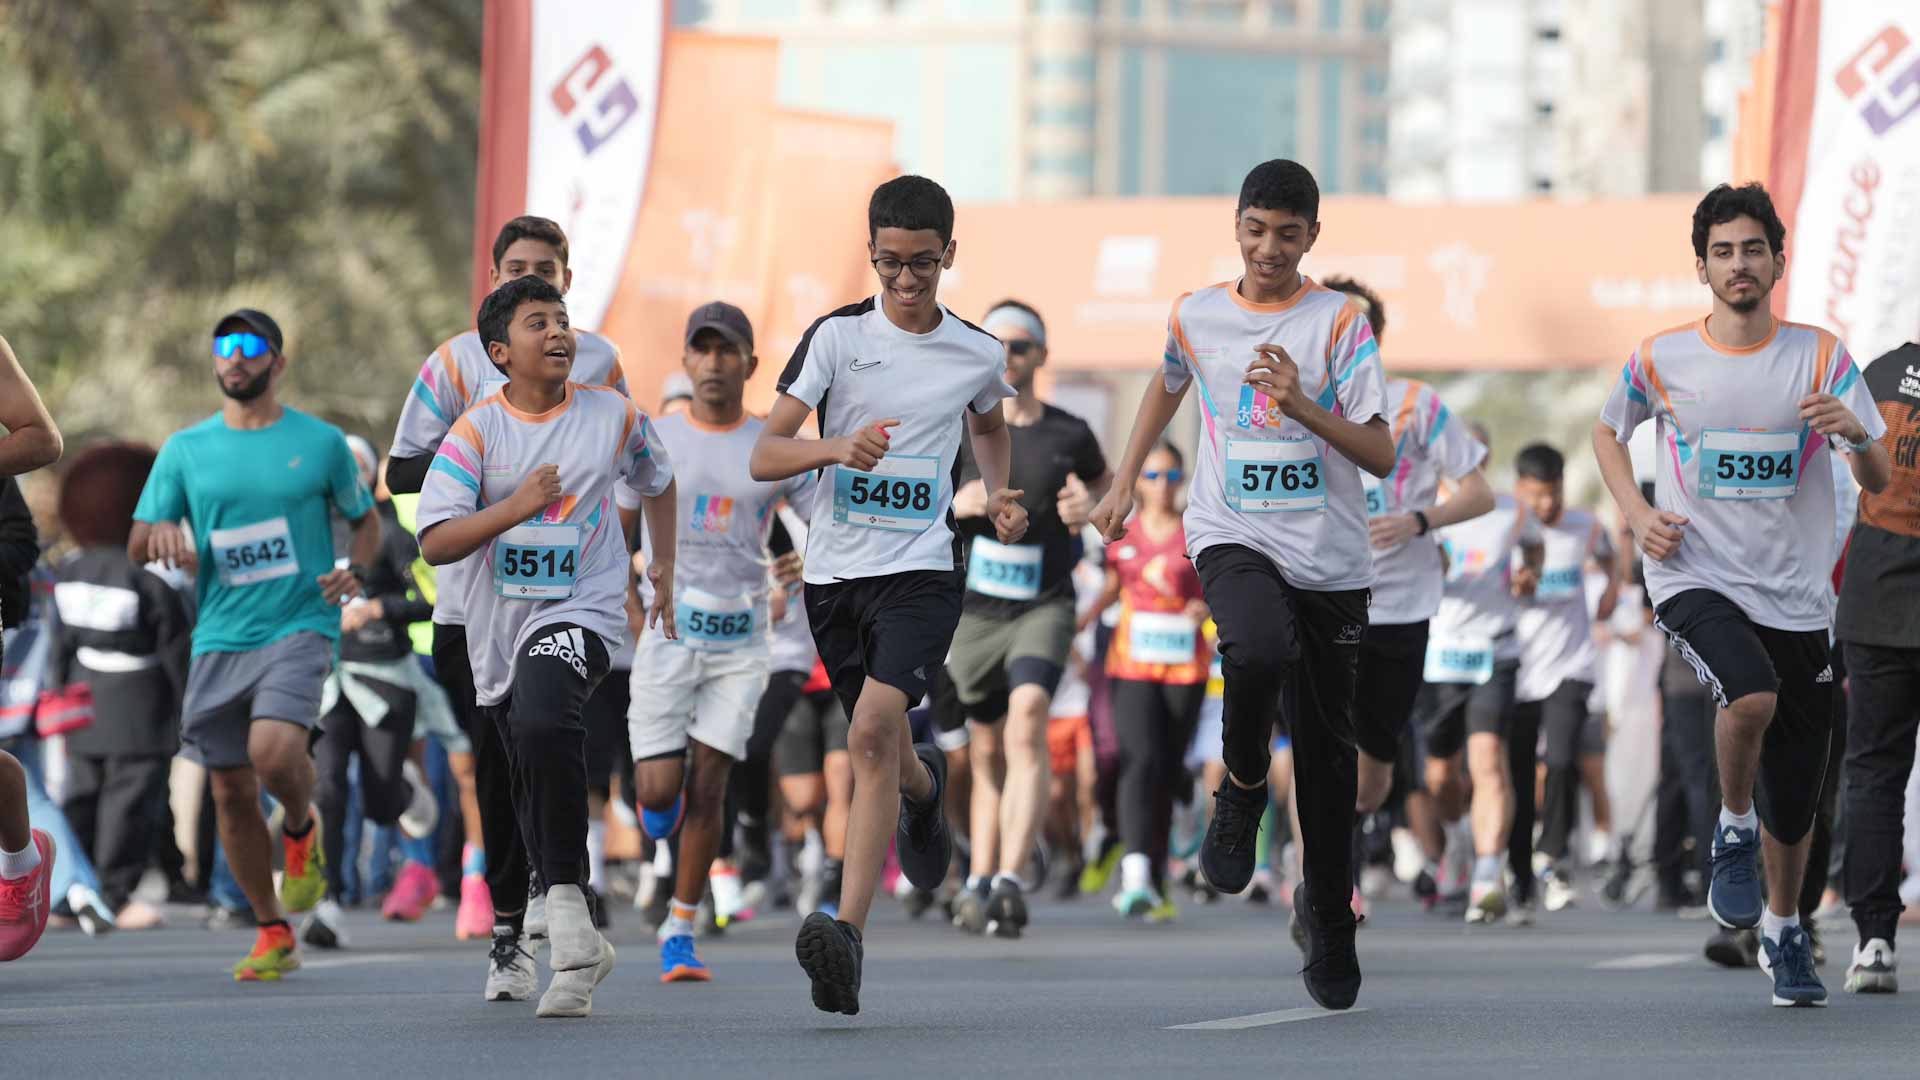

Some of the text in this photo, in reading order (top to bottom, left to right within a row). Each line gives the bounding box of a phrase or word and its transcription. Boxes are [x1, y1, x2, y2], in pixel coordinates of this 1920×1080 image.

[1242, 462, 1320, 492] 5763
[1717, 453, 1793, 480] 5394
[850, 476, 931, 511] 5498
[225, 538, 289, 570] 5642
[504, 548, 575, 578] 5514
[688, 611, 750, 637] 5562
[528, 643, 588, 680] adidas
